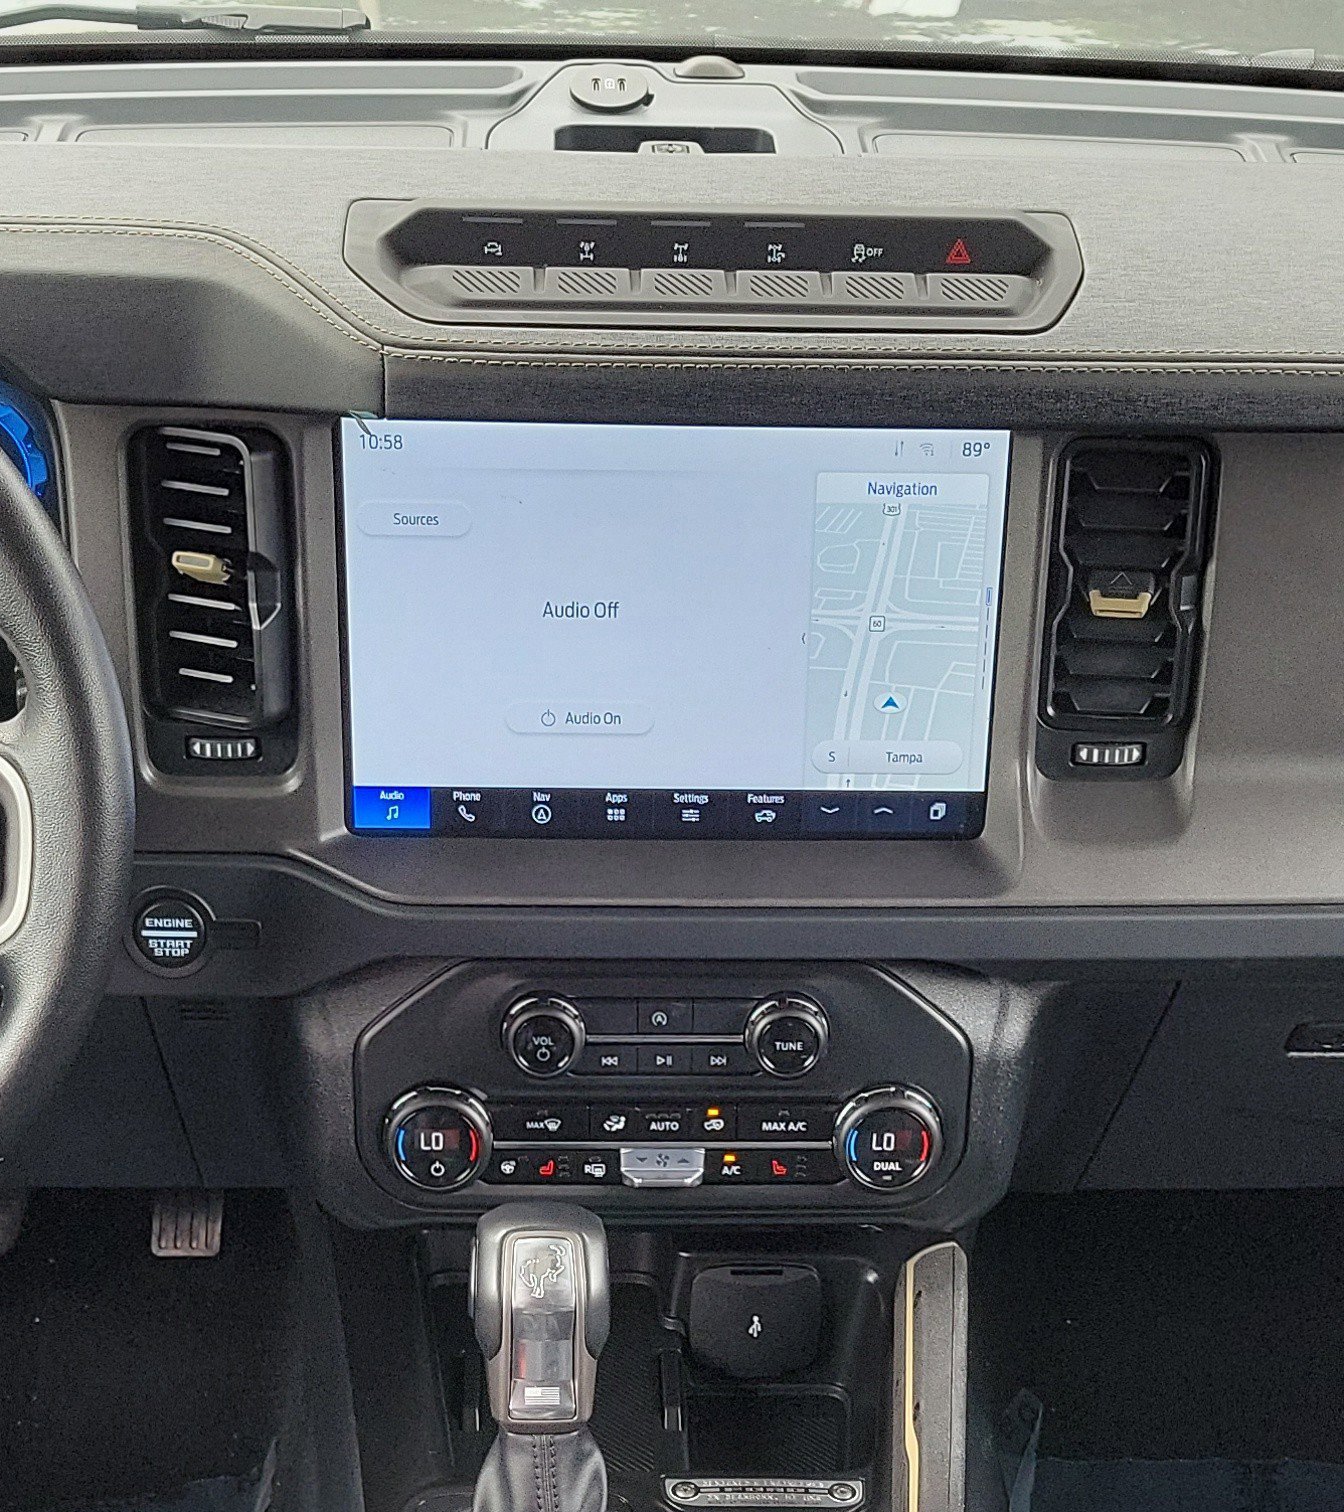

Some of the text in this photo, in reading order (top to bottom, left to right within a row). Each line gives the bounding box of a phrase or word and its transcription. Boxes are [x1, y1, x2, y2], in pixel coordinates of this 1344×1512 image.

[866, 247, 884, 257] OFF
[359, 434, 403, 450] 10:58
[867, 481, 938, 498] Navigation
[393, 513, 440, 526] Sources
[543, 600, 620, 620] Audio Off
[565, 710, 622, 726] Audio On
[828, 751, 836, 763] S
[885, 751, 924, 767] Tampa
[380, 790, 405, 800] Audio
[453, 791, 482, 801] Phone
[533, 792, 551, 801] Nav
[605, 792, 628, 804] Apps
[673, 793, 709, 804] Settings
[747, 794, 785, 804] Features
[145, 918, 193, 928] ENGINE
[148, 939, 193, 949] START
[154, 948, 190, 957] STOP
[533, 1036, 555, 1046] VOL
[775, 1041, 804, 1052] TUNE
[526, 1121, 545, 1130] MAX
[649, 1121, 680, 1131] AUTO
[762, 1122, 807, 1132] MAX A/C
[721, 1165, 741, 1176] A/C
[873, 1161, 903, 1171] DUAL
